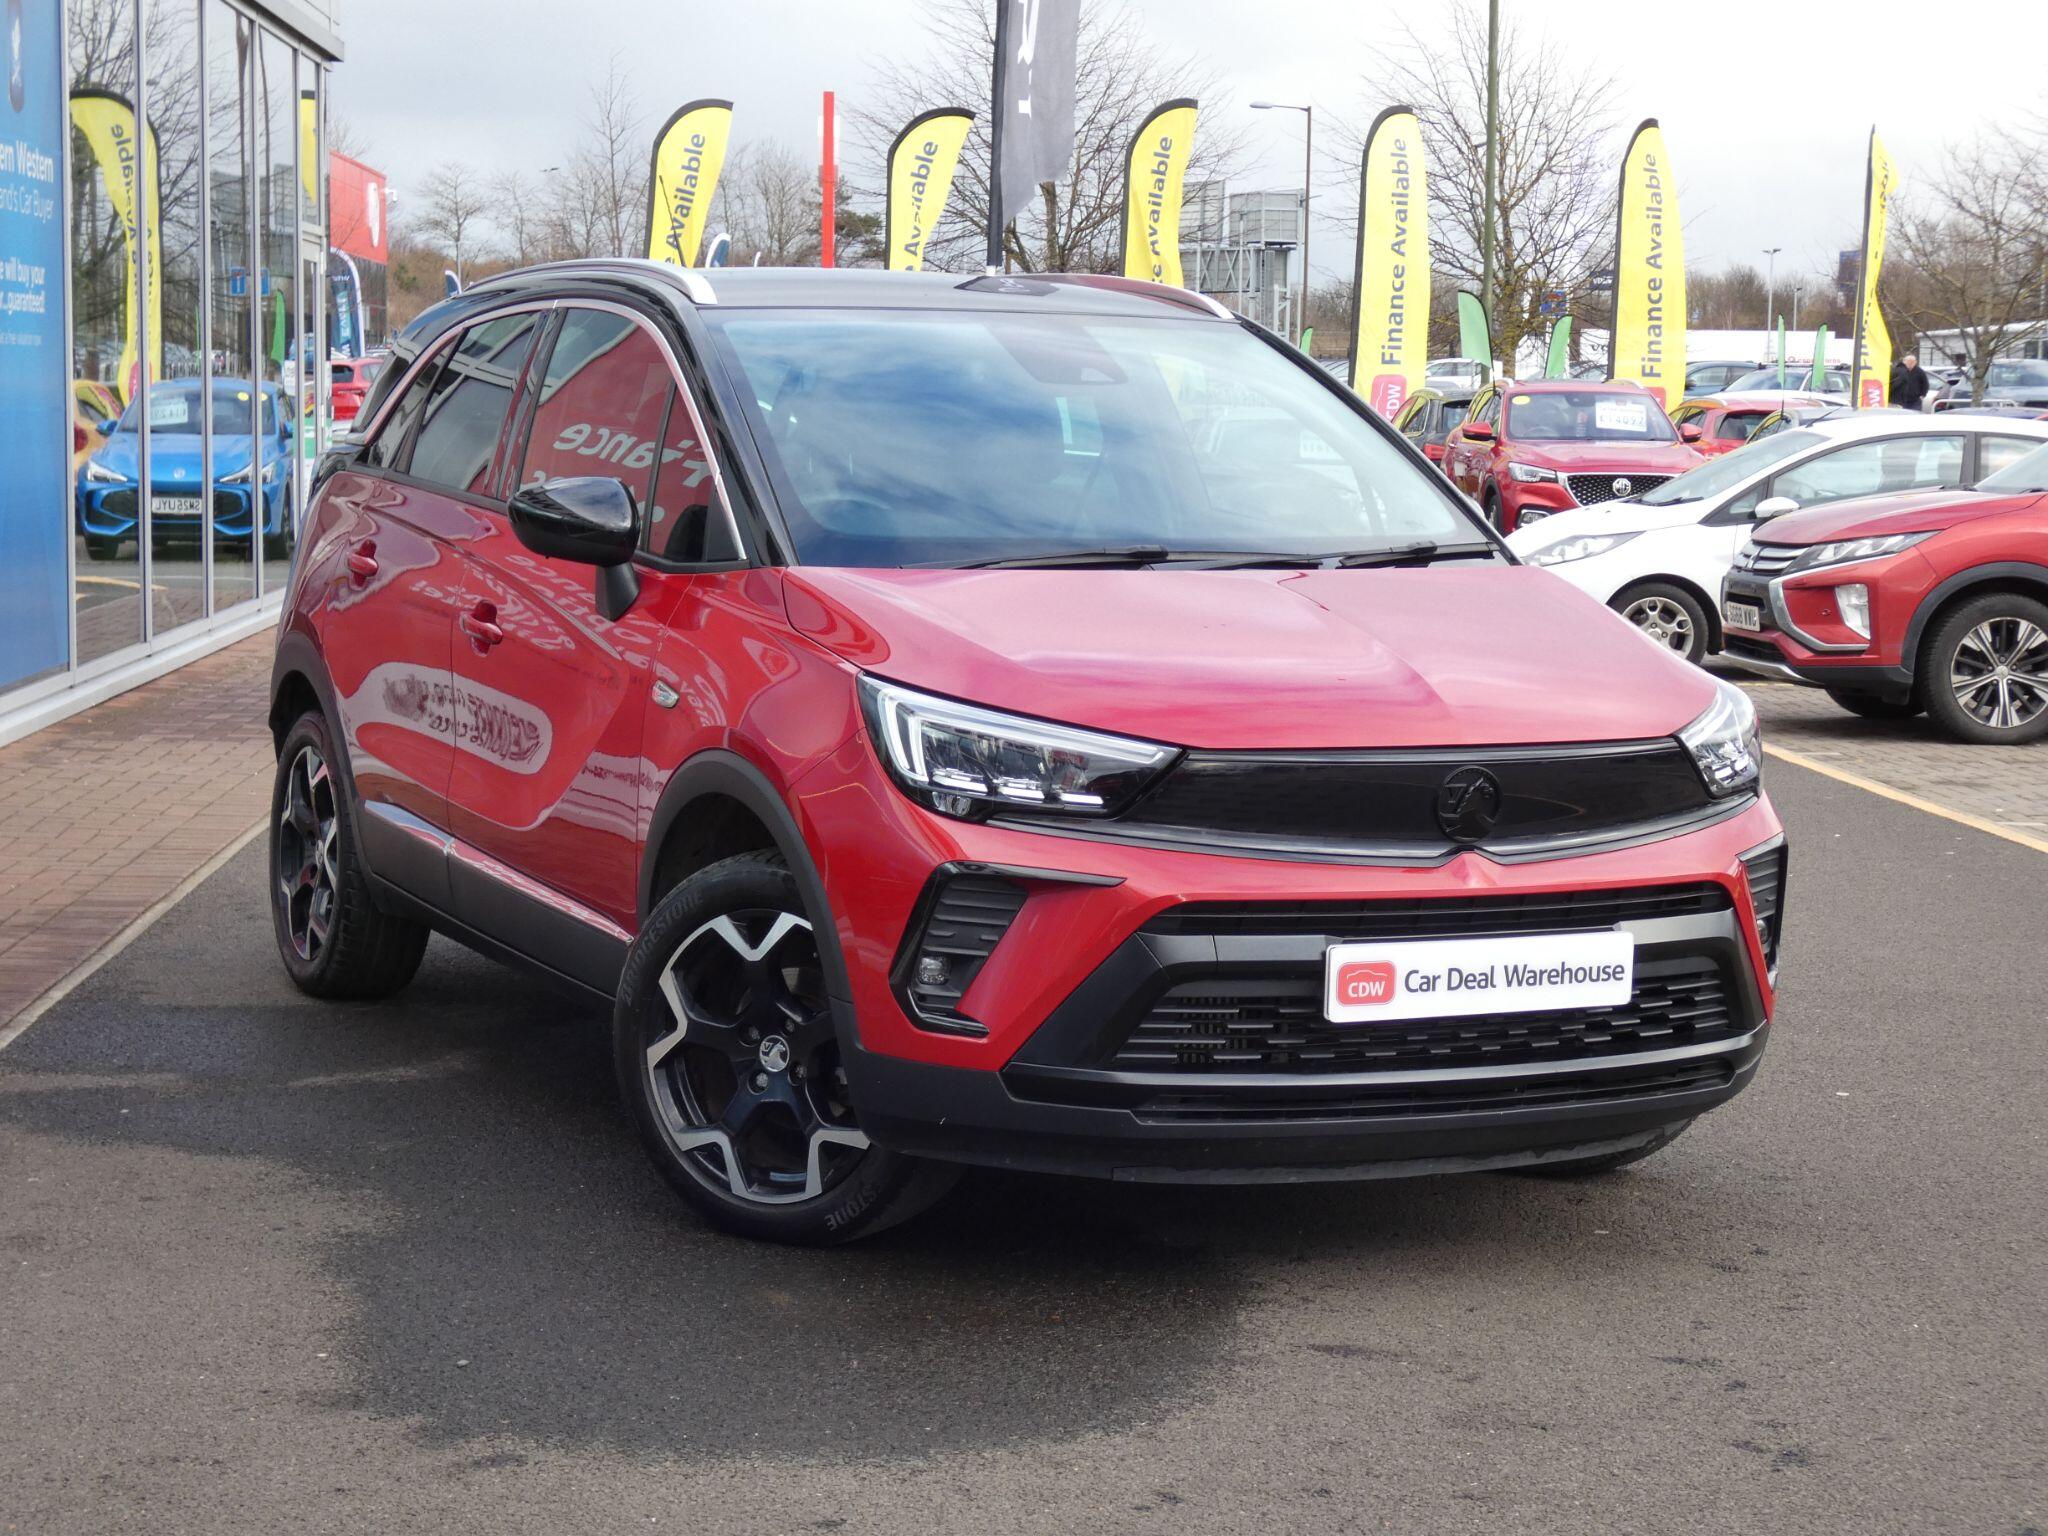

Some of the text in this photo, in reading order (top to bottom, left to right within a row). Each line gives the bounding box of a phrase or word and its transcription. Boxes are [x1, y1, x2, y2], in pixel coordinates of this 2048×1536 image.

[16, 140, 54, 183] Western
[666, 134, 706, 250] Available
[1148, 136, 1173, 256] Available
[1381, 138, 1410, 365] Finance Available
[1641, 153, 1663, 378] Finance Available
[1348, 961, 1625, 998] CDW Car Deal Warehouse
